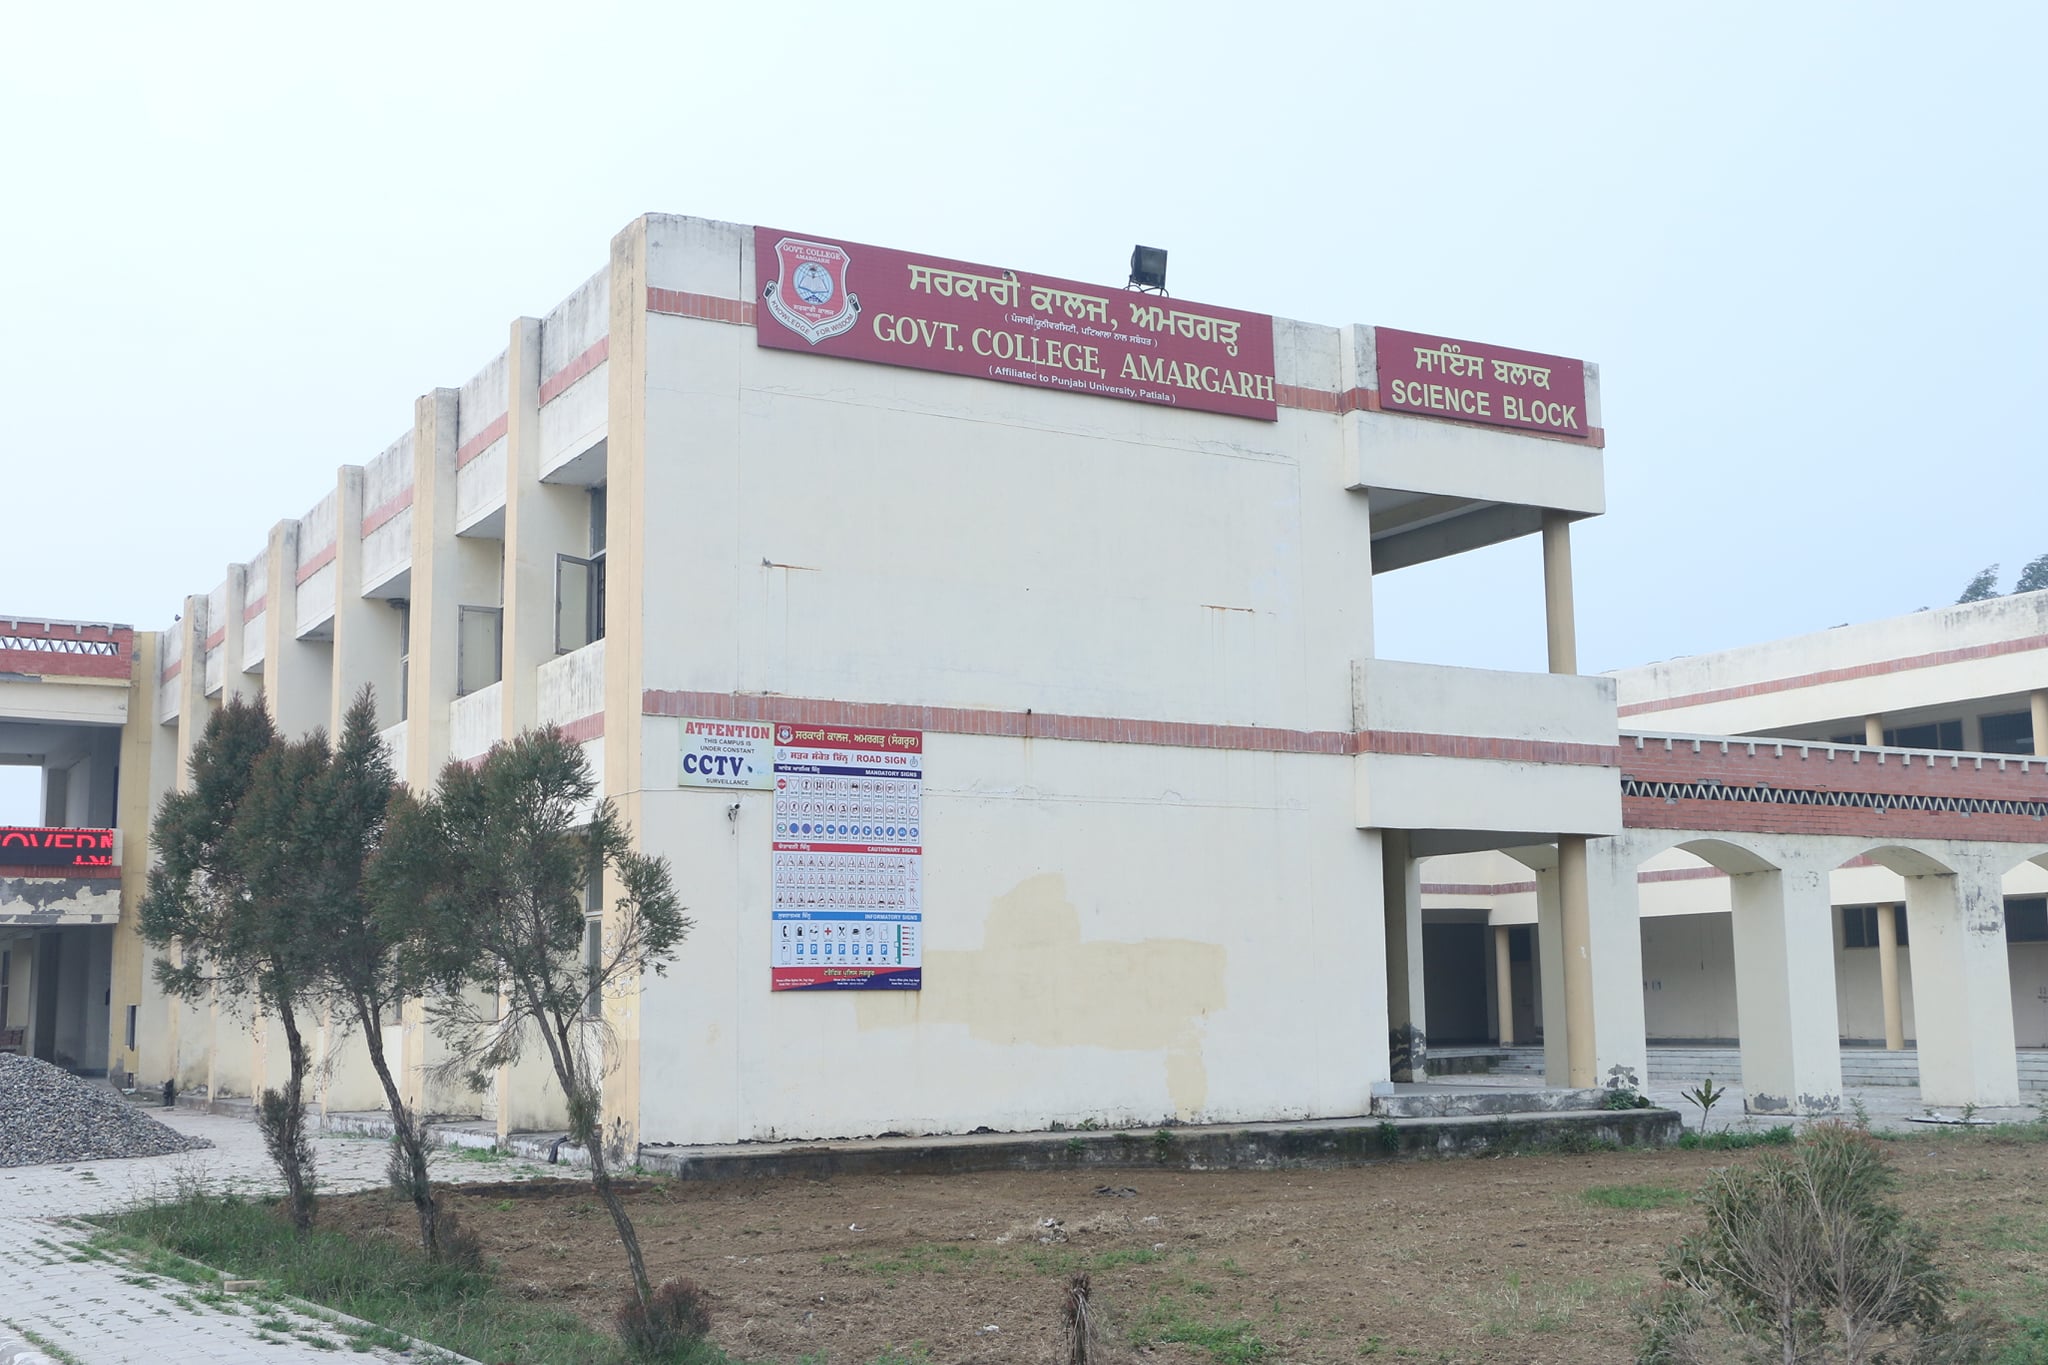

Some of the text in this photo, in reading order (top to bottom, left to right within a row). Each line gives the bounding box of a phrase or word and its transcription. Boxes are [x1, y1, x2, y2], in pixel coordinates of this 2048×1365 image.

[806, 248, 840, 260] COLLEGE
[771, 300, 854, 336] KNOWLEDGE FOR WISDOM
[907, 264, 1241, 357] ਸਰਕਾਰੀ ਕਾਲਜ, ਅਮਰਗੜ੍ਹ
[873, 313, 1275, 402] GOVT. COLLEGE, AMARGARH
[1413, 343, 1551, 390] ਸਾਇੰਸ ਬਲਾਕ
[995, 366, 1037, 380] Affiliated
[1039, 373, 1049, 382] to
[1051, 375, 1087, 389] Punjabi
[1089, 381, 1137, 398] University,
[1139, 389, 1170, 401] Patiala
[1391, 379, 1578, 430] SCIENCE BLOCK
[685, 721, 769, 739] ATTENTION
[722, 746, 755, 754] CONSTANT
[856, 754, 881, 763] ROAD
[884, 755, 906, 764] SIGN
[683, 753, 744, 777] CCTV
[865, 769, 899, 777] MANDATORY
[706, 778, 749, 786] SURVEILLANCE
